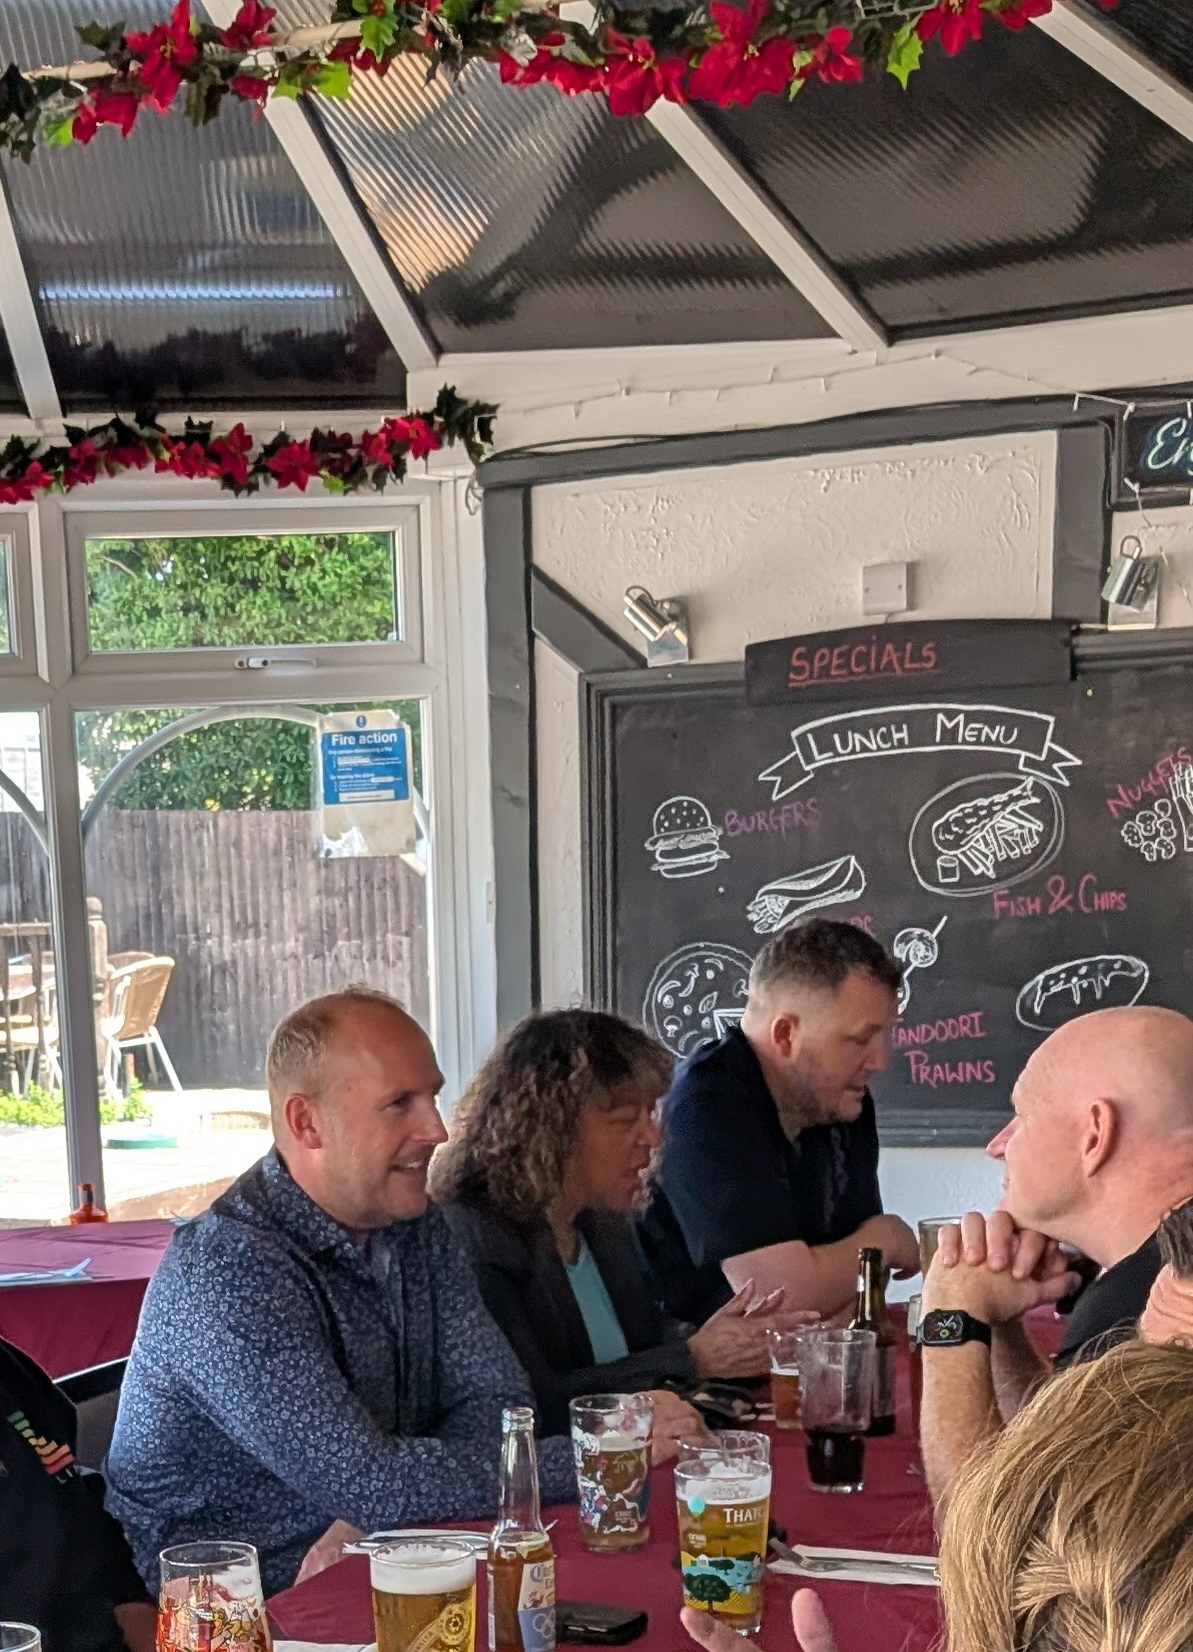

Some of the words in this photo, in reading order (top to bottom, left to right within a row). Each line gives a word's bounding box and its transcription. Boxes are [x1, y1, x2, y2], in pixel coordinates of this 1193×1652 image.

[788, 637, 938, 686] SPECIALS
[331, 734, 356, 747] Fire
[359, 732, 398, 744] action
[806, 723, 910, 762] LUNCH
[935, 712, 1020, 745] MENU
[723, 798, 824, 838] BURGERS
[992, 887, 1042, 919] FISH
[1047, 876, 1075, 915] &
[1078, 874, 1128, 912] CHIPS
[904, 1050, 997, 1089] PRAWNS
